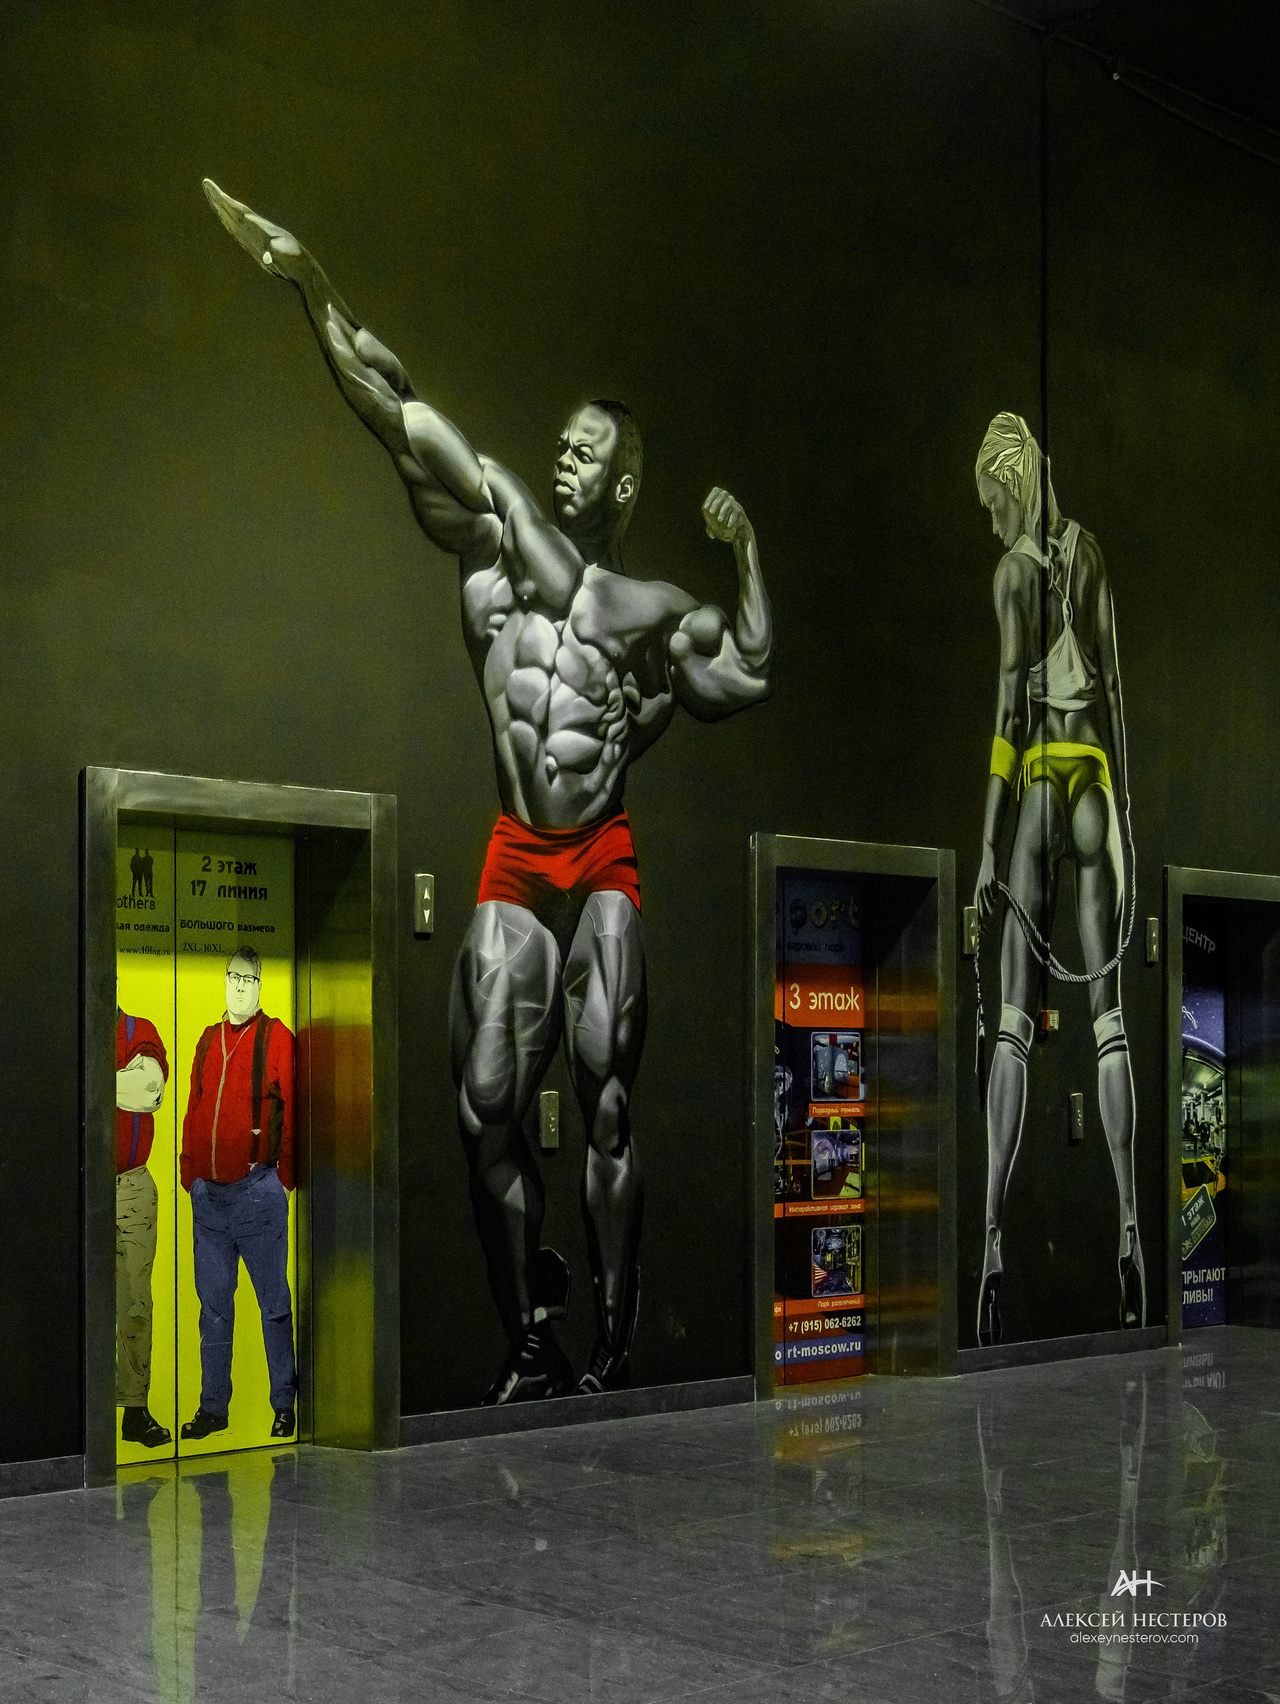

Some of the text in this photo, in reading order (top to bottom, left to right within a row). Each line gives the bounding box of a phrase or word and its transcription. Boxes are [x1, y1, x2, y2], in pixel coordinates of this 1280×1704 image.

[201, 855, 258, 876] 2 этаж
[190, 879, 268, 901] 17 линия
[133, 922, 170, 933] одежда
[789, 983, 860, 1011] 3 этаж
[1182, 1288, 1214, 1305] ЛИВЫ!
[788, 1315, 862, 1335] +7 (915) 062-6262
